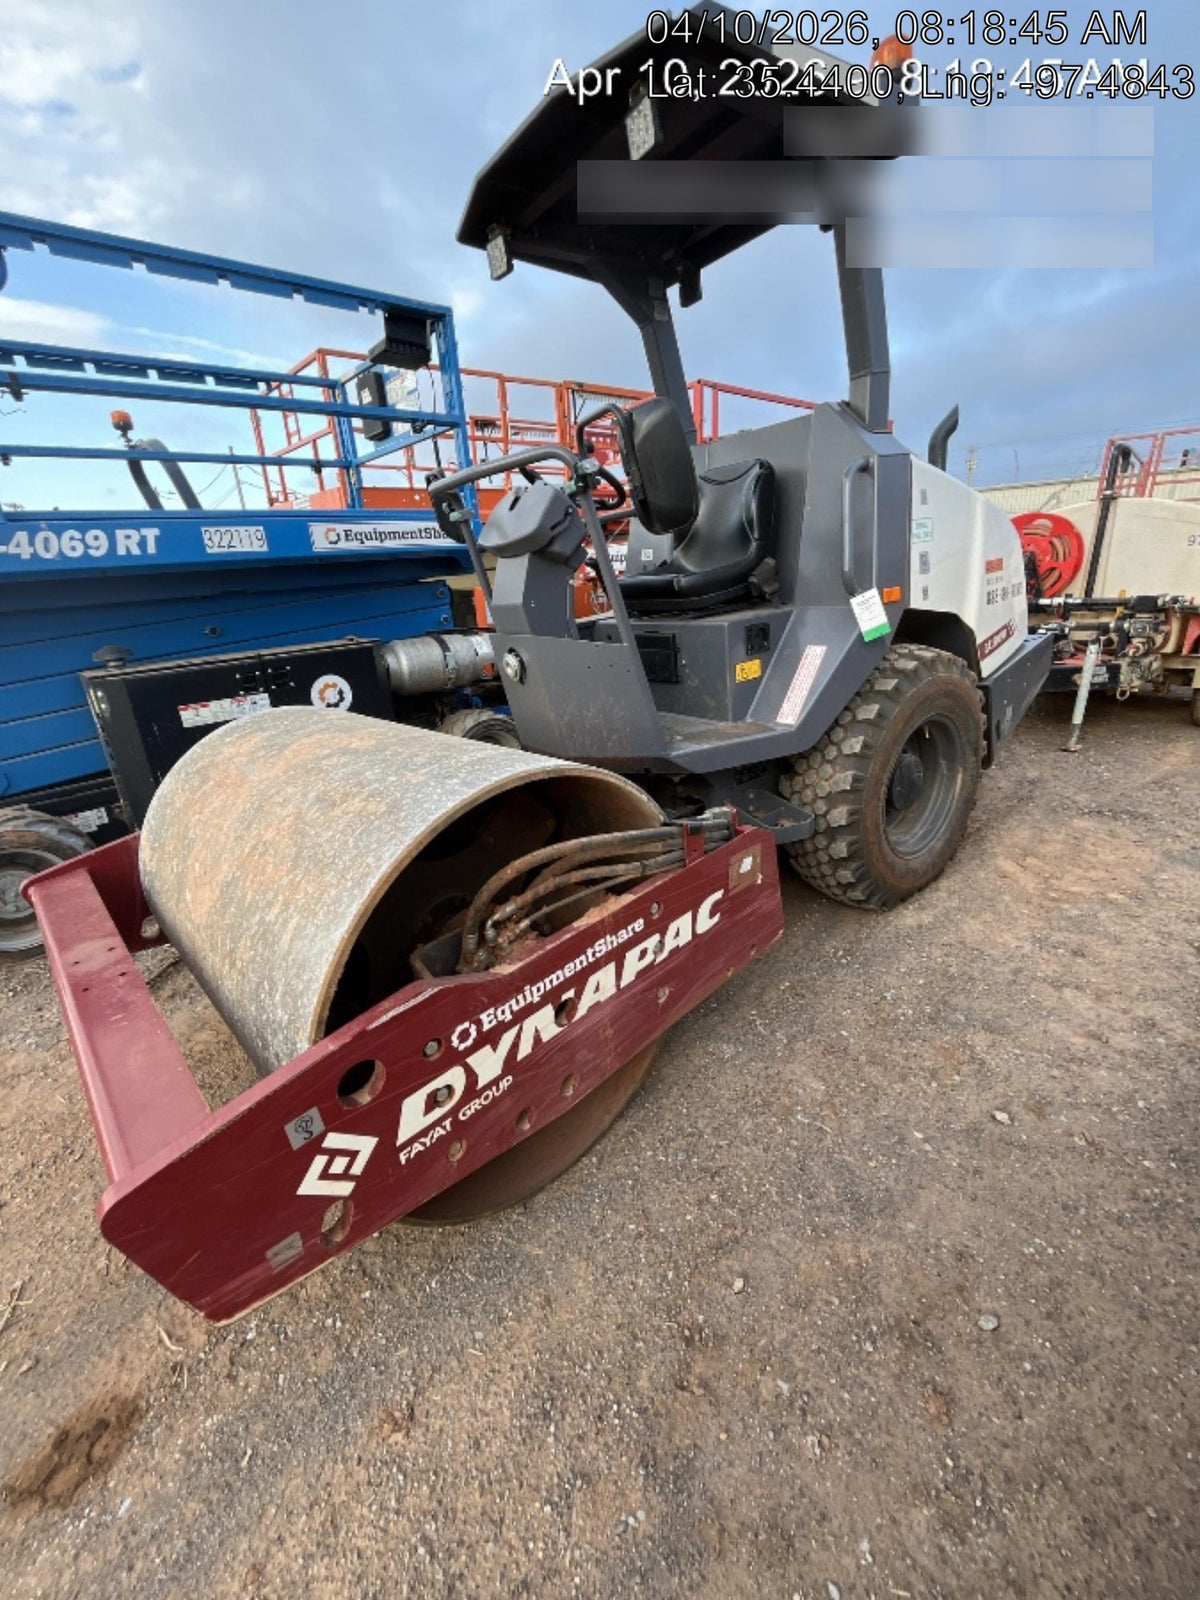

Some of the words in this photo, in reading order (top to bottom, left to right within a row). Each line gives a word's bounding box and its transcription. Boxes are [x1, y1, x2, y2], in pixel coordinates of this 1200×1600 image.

[115, 528, 160, 556] RT
[204, 529, 266, 549] 322119
[343, 527, 448, 544] EquipmentSha
[479, 917, 645, 1032] EquipmentShare
[396, 889, 725, 1147] DYNAPAC
[399, 1118, 453, 1166] FAYAT
[458, 1075, 514, 1122] GROUP
